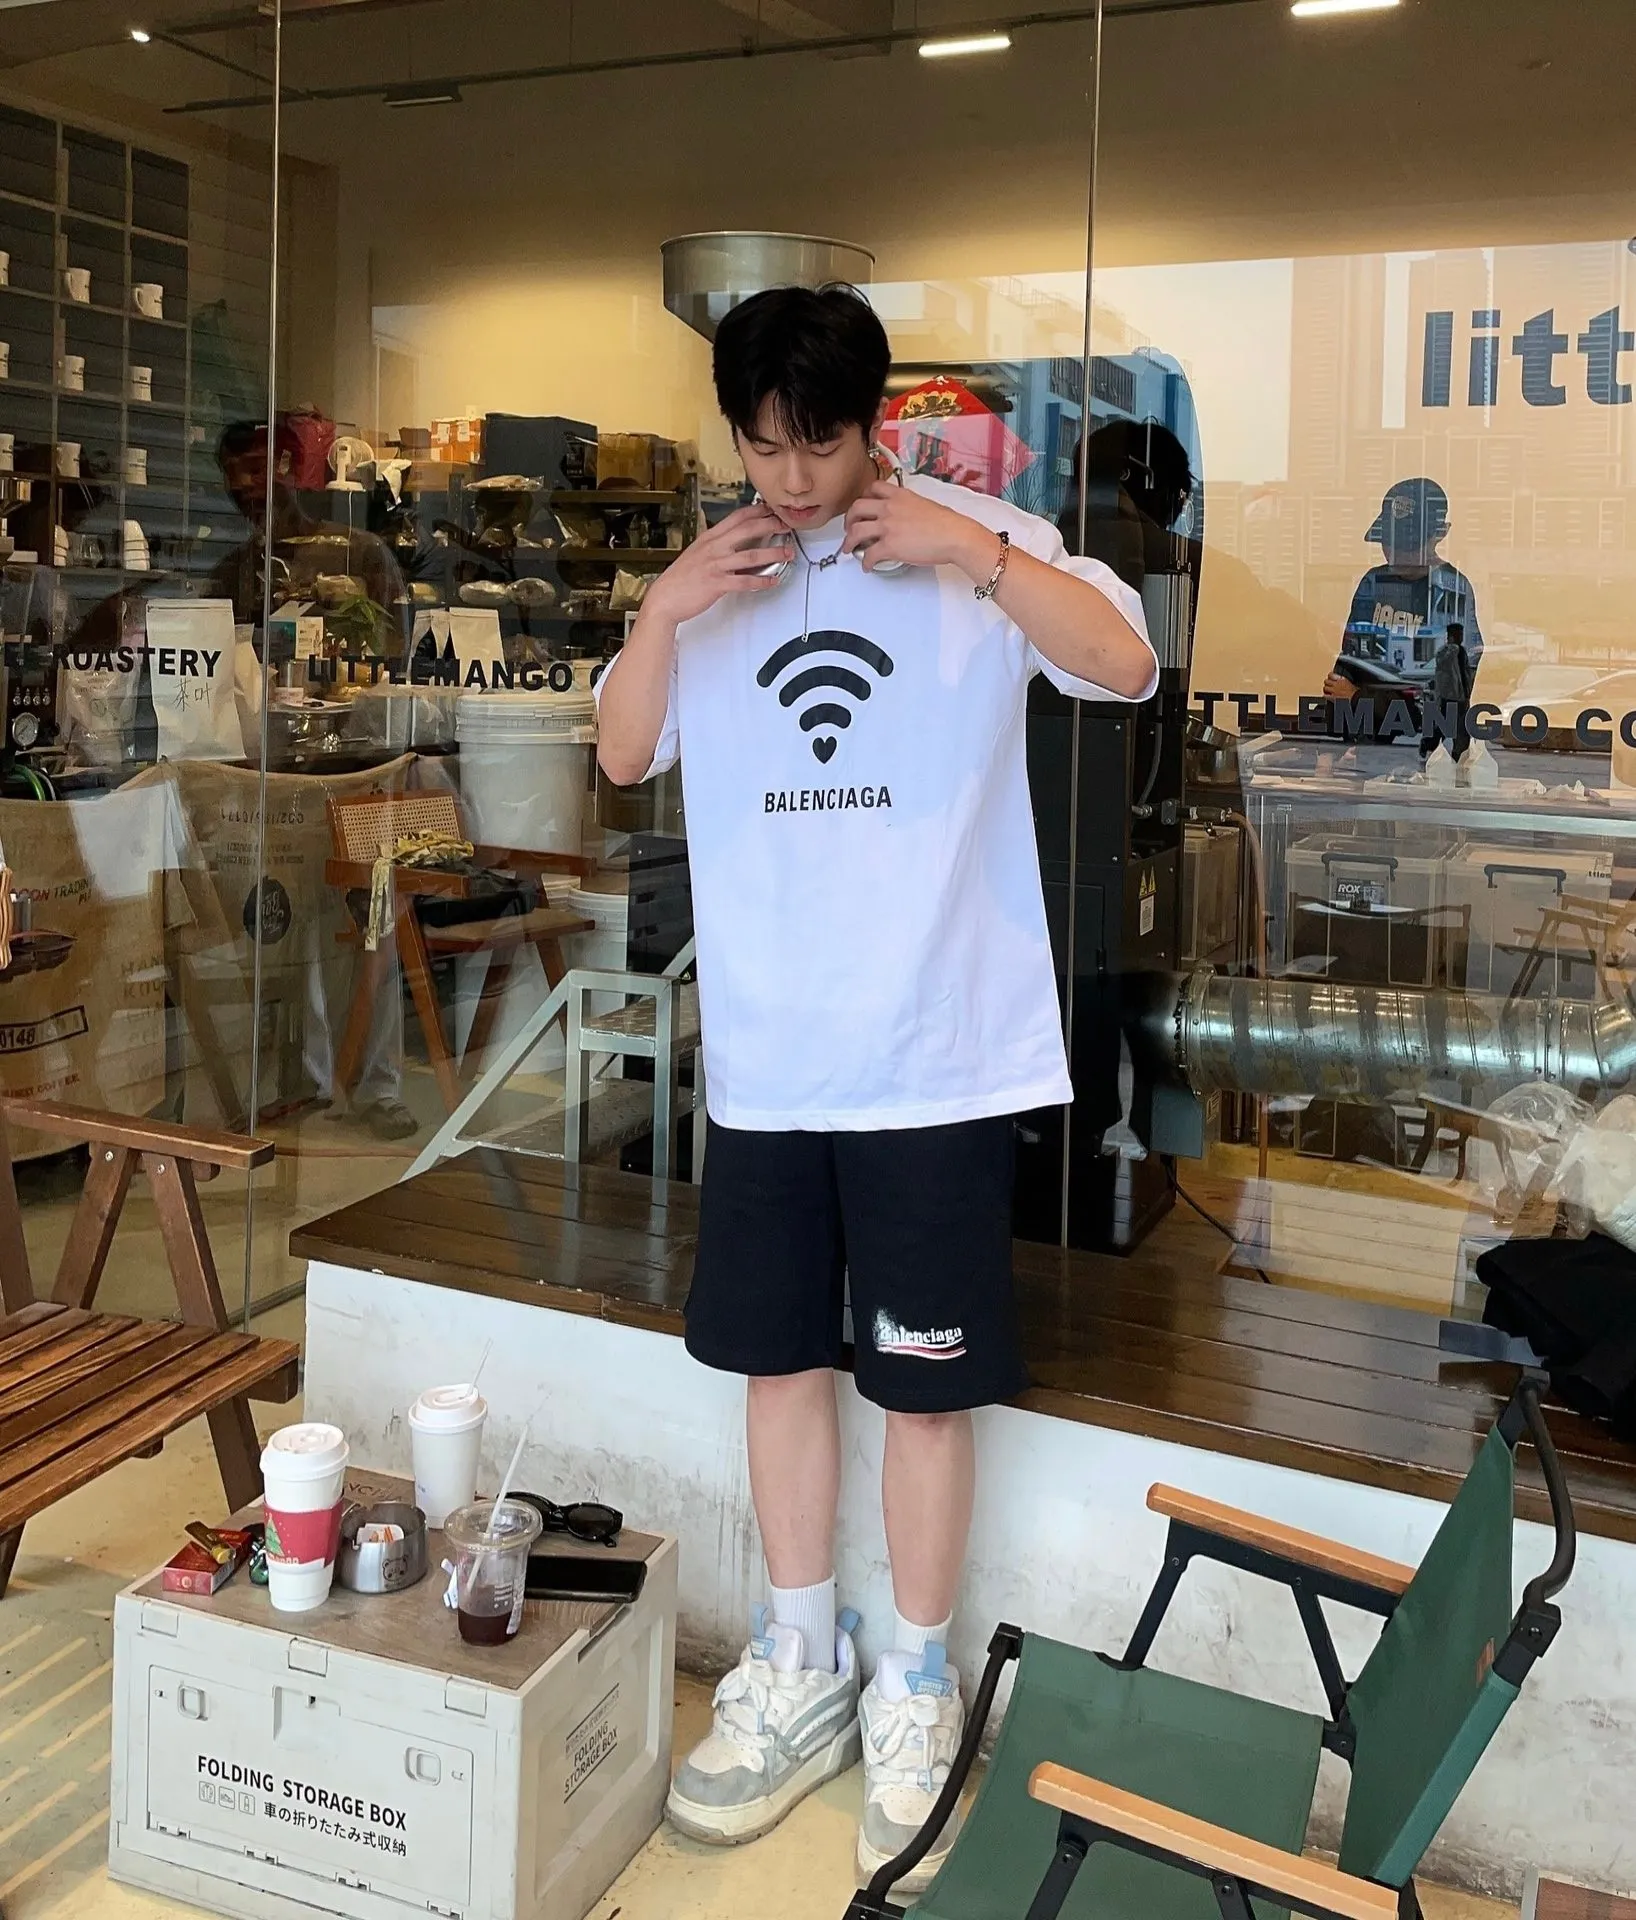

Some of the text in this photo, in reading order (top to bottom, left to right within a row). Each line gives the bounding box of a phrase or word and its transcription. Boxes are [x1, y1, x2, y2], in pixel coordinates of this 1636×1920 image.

[1421, 304, 1635, 408] litt
[53, 645, 223, 678] ROASTERY
[309, 653, 574, 693] LITTLEMANGO
[1152, 690, 1549, 744] TTLEMANGO
[764, 785, 893, 813] BALENCIAGA
[1338, 883, 1360, 893] ROX
[564, 1744, 601, 1794] STORAGE
[602, 1726, 618, 1752] BOX
[574, 1721, 608, 1767] FOLDING
[198, 1755, 407, 1831] FOLDING STORAGE BOX
[263, 1801, 407, 1857] 車の折りたたみ式収納
